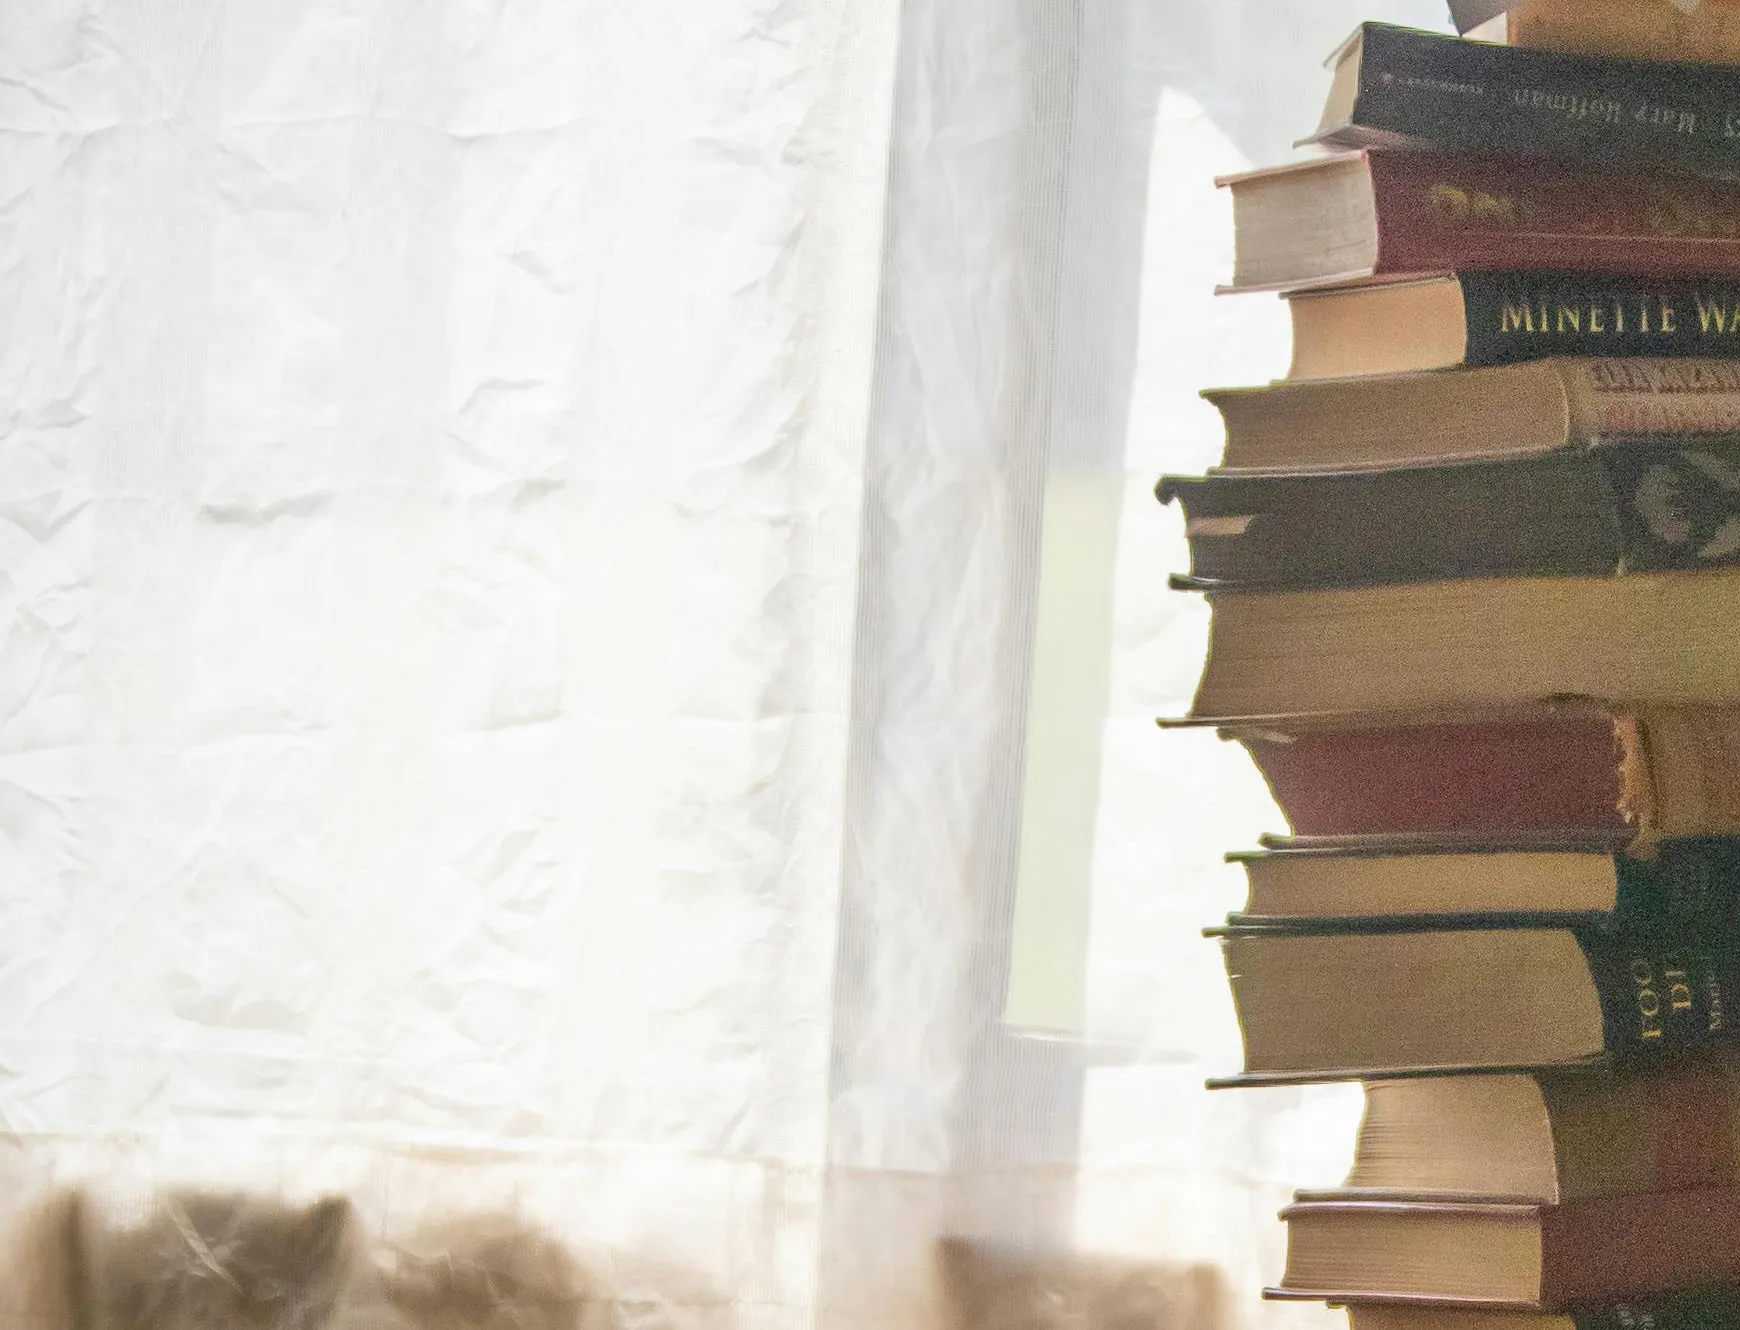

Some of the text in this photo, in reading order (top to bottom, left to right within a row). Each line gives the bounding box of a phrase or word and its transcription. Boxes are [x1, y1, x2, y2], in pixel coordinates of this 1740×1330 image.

[1513, 88, 1622, 123] Hoffman
[1635, 104, 1697, 134] Mary
[1500, 297, 1677, 334] MINETTE
